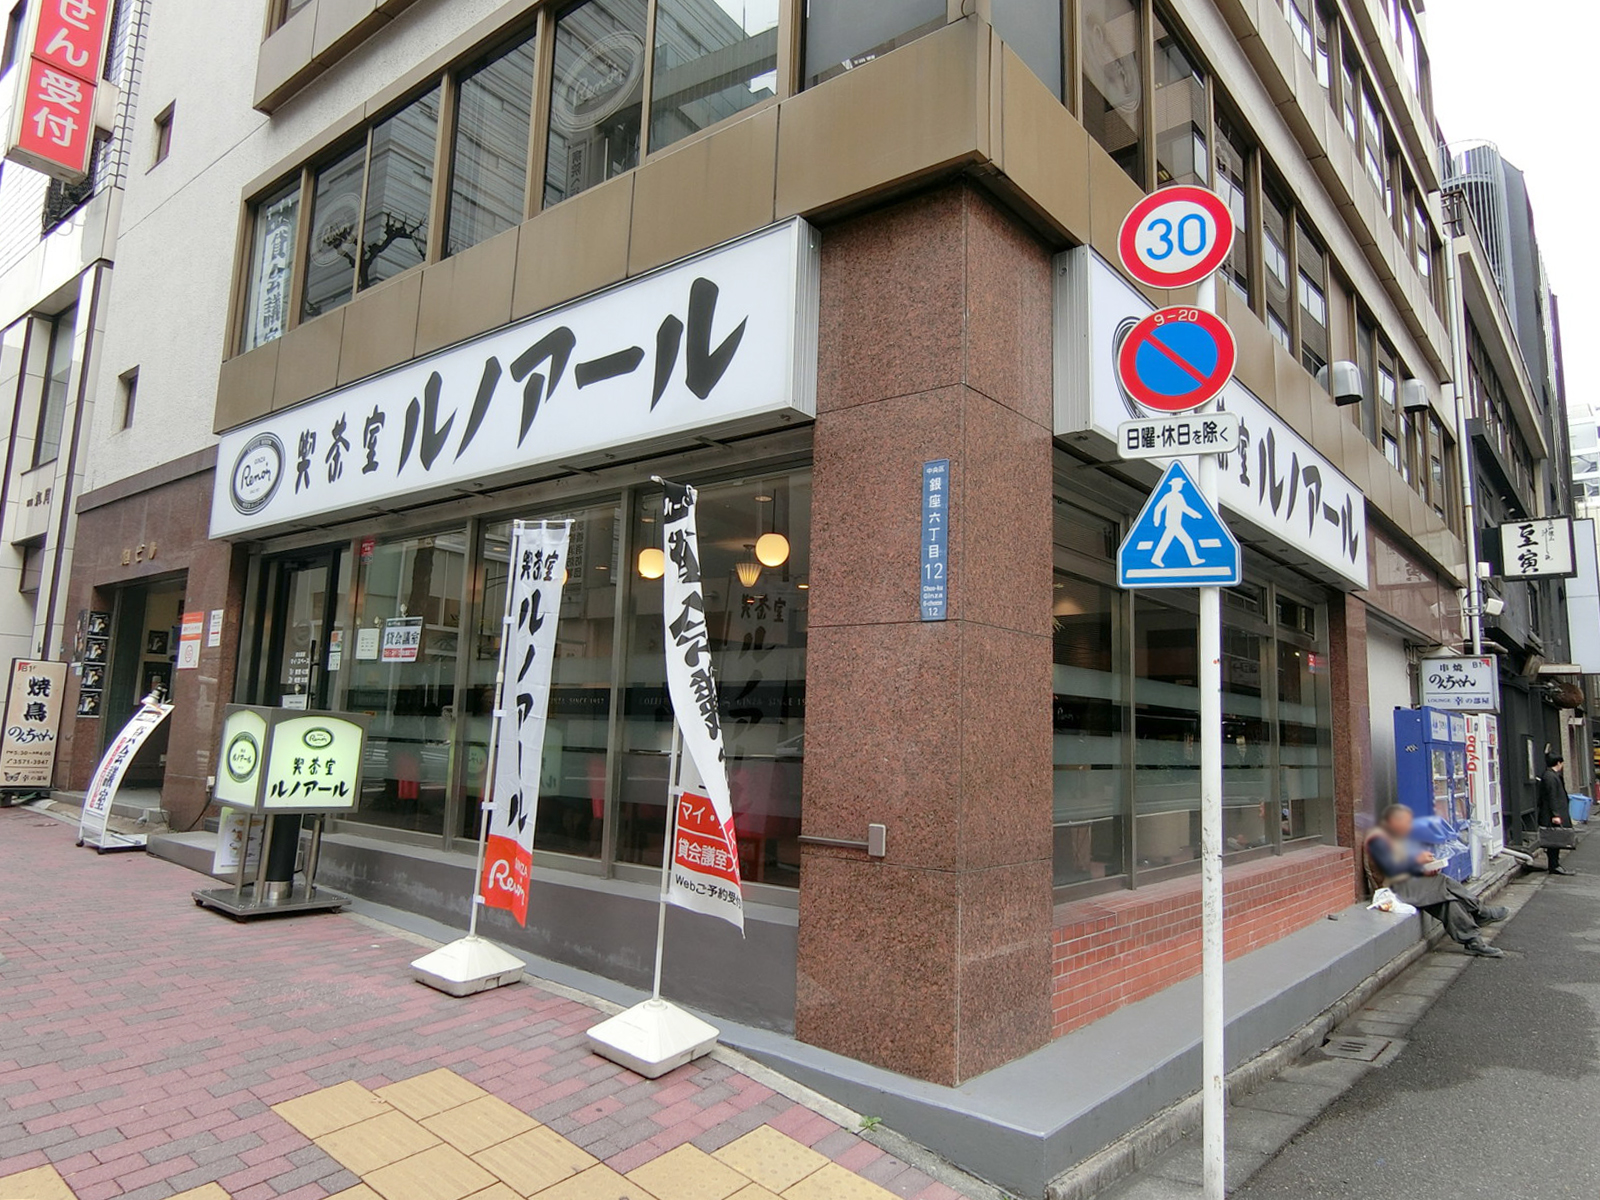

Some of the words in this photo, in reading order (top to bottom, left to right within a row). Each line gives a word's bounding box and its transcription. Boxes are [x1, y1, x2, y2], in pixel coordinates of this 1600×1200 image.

[1146, 213, 1206, 260] 30
[1154, 309, 1199, 326] 9-20
[397, 277, 749, 477] ルノアール
[1127, 421, 1229, 450] 日曜・休日を除く
[1258, 427, 1359, 565] ルノアール
[928, 477, 941, 559] 銀座六丁目
[924, 562, 943, 580] 12
[928, 607, 939, 616] 12
[386, 631, 419, 646] 貸会議室
[1428, 674, 1476, 691] のんちゃん
[23, 676, 51, 722] 焼鳥
[507, 588, 546, 835] ルノアール
[8, 726, 54, 743] のんちゃん
[1466, 735, 1479, 771] DyDo
[293, 757, 336, 775] 喫茶室
[270, 780, 349, 798] ルノアール
